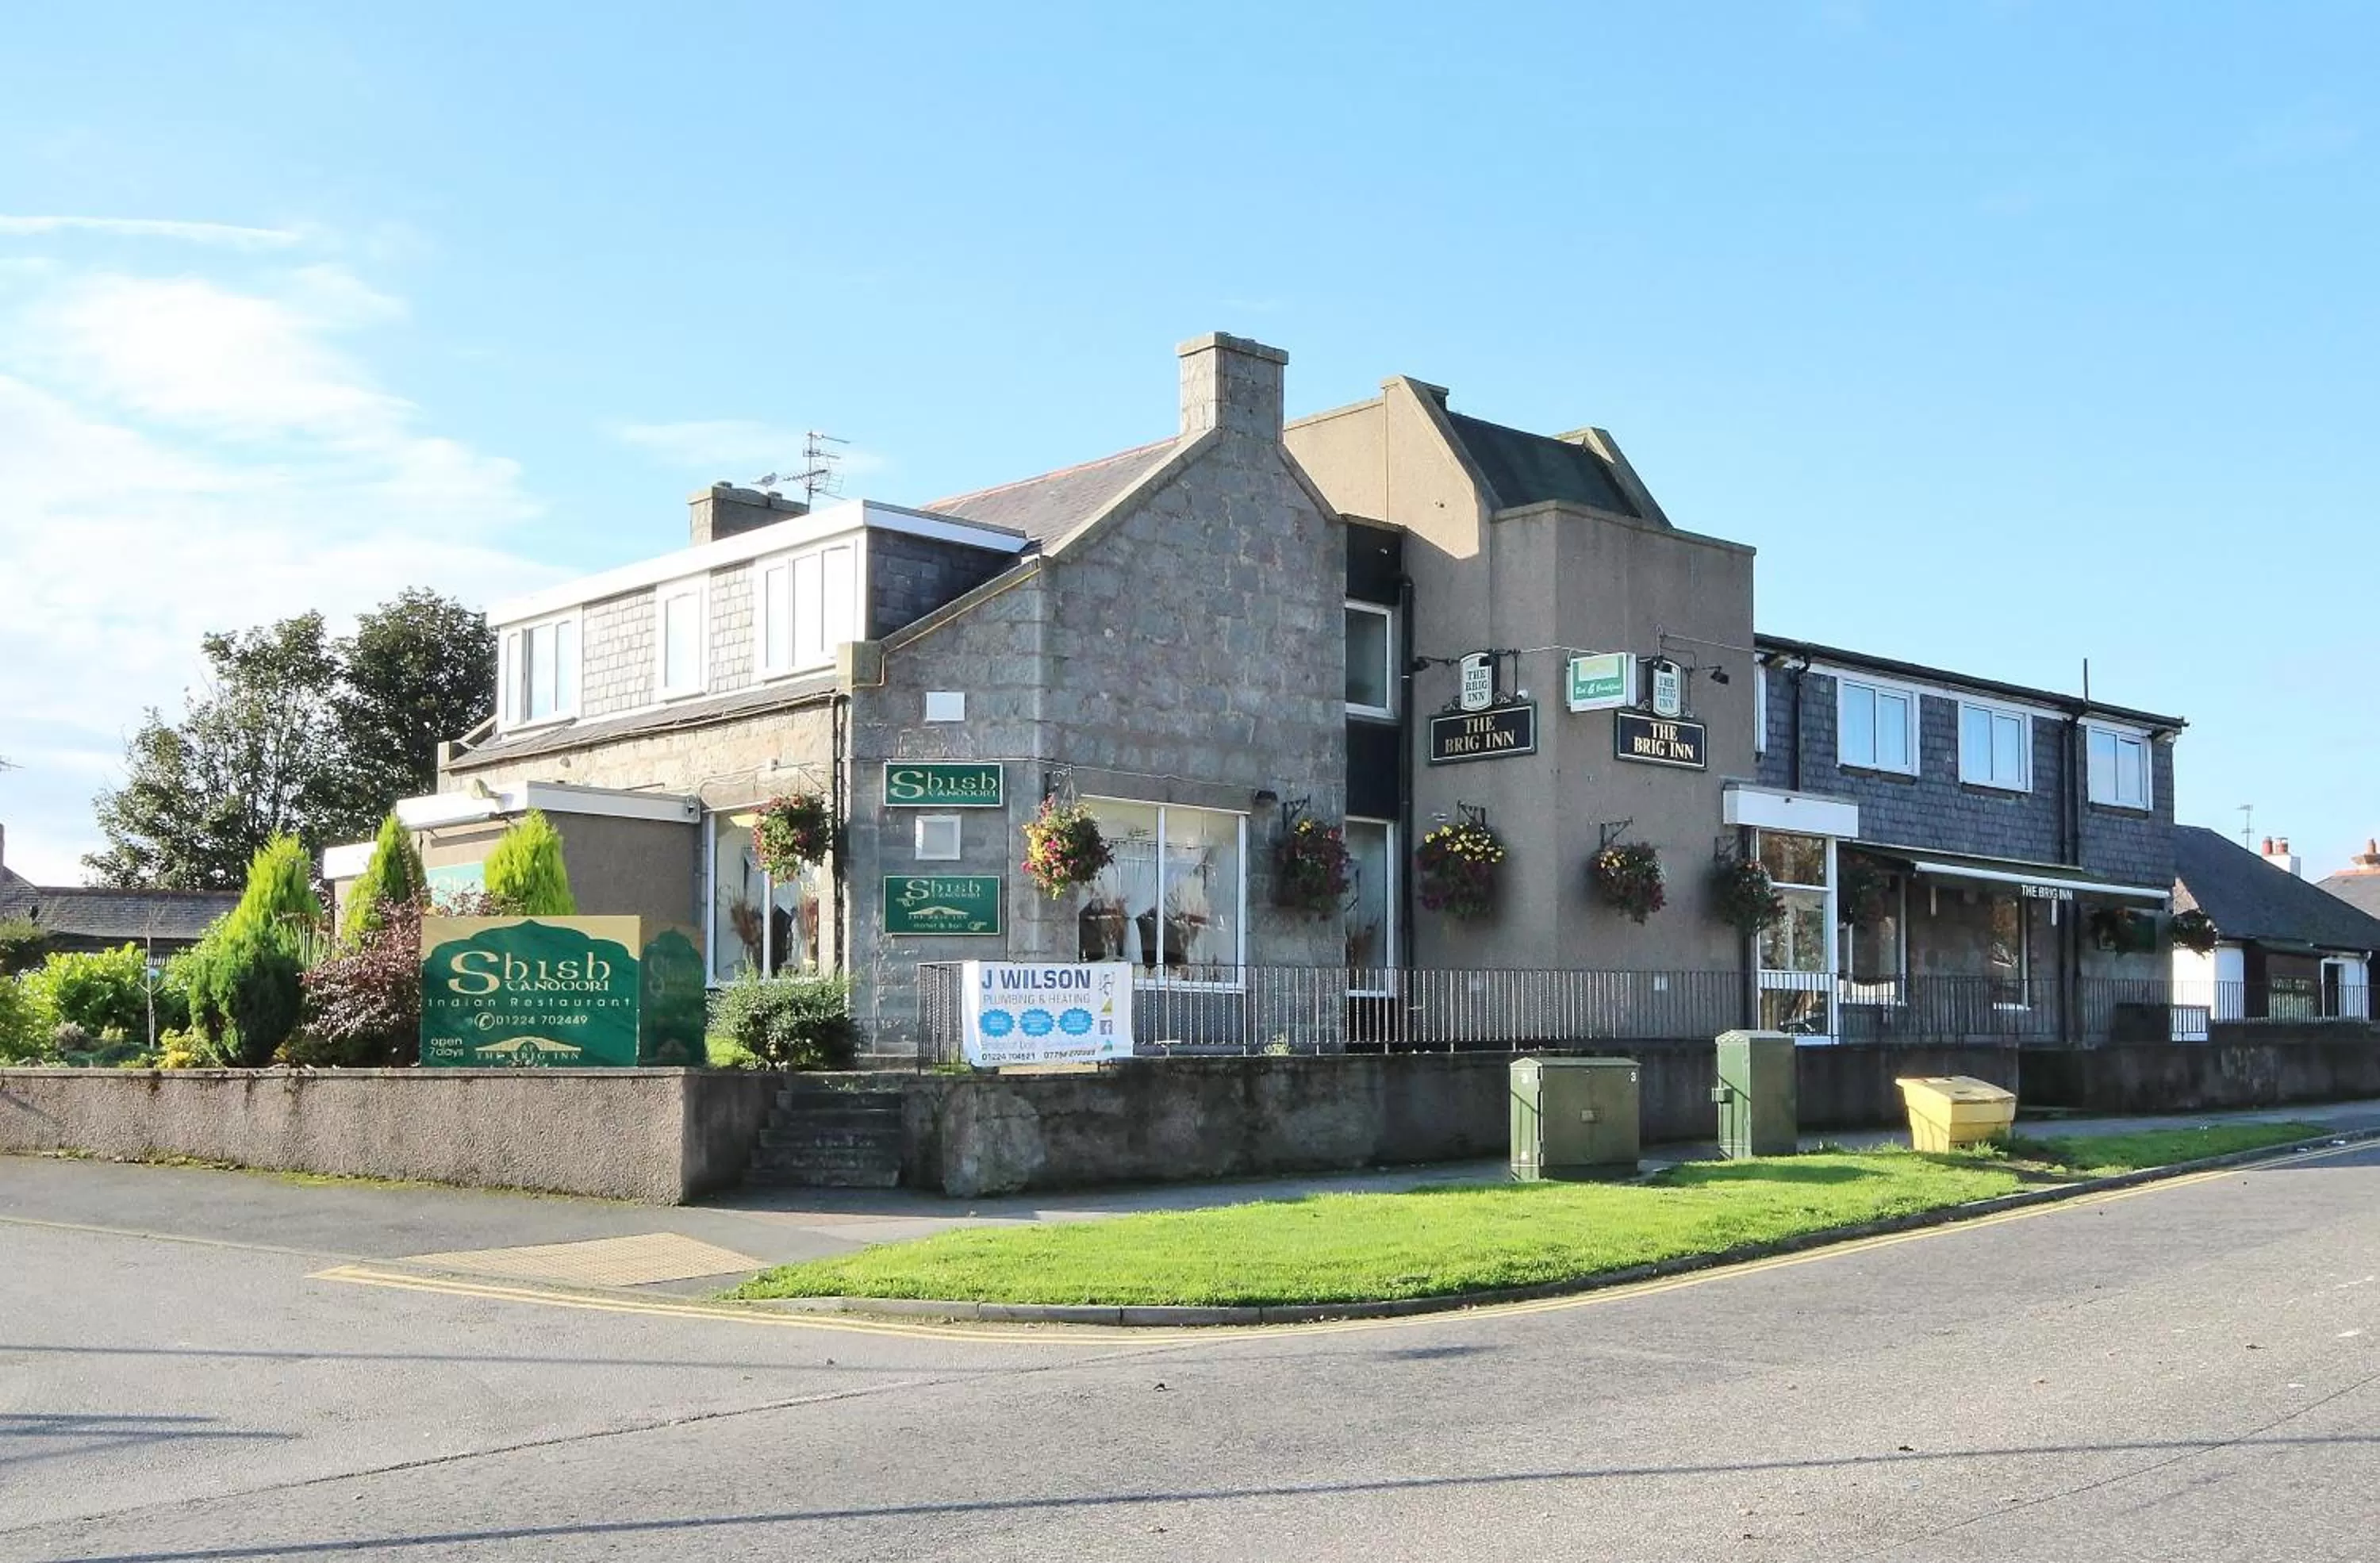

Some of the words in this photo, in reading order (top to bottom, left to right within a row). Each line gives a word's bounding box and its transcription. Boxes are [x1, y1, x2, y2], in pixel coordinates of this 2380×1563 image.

[1467, 670, 1486, 680] THE
[1658, 675, 1675, 688] THE
[1465, 680, 1488, 691] BRIG
[1467, 692, 1486, 702] INN
[1656, 686, 1676, 699] BRIG
[1658, 697, 1675, 708] INN
[1464, 716, 1495, 733] THE
[1650, 723, 1678, 742] THE
[1445, 735, 1480, 754] BRIG
[1486, 731, 1515, 748] INN
[1633, 737, 1666, 755] BRIG
[1670, 743, 1695, 759] INN
[889, 770, 997, 799] Shish
[905, 879, 981, 900] Shish
[2021, 885, 2037, 897] THE
[2038, 886, 2059, 899] BRIG
[2059, 889, 2073, 901] INN
[448, 951, 610, 995] Shish
[981, 970, 992, 989] J
[1000, 969, 1091, 989] WILSON
[428, 997, 496, 1008] Indian
[510, 997, 630, 1008] Restaurant
[983, 993, 1035, 1005] PLUMBING
[1048, 993, 1091, 1004] HEATING
[496, 1016, 536, 1026] 01224
[541, 1015, 589, 1025] 702449
[430, 1037, 463, 1047] open
[555, 1052, 580, 1061] INN
[1630, 1072, 1637, 1082] 3
